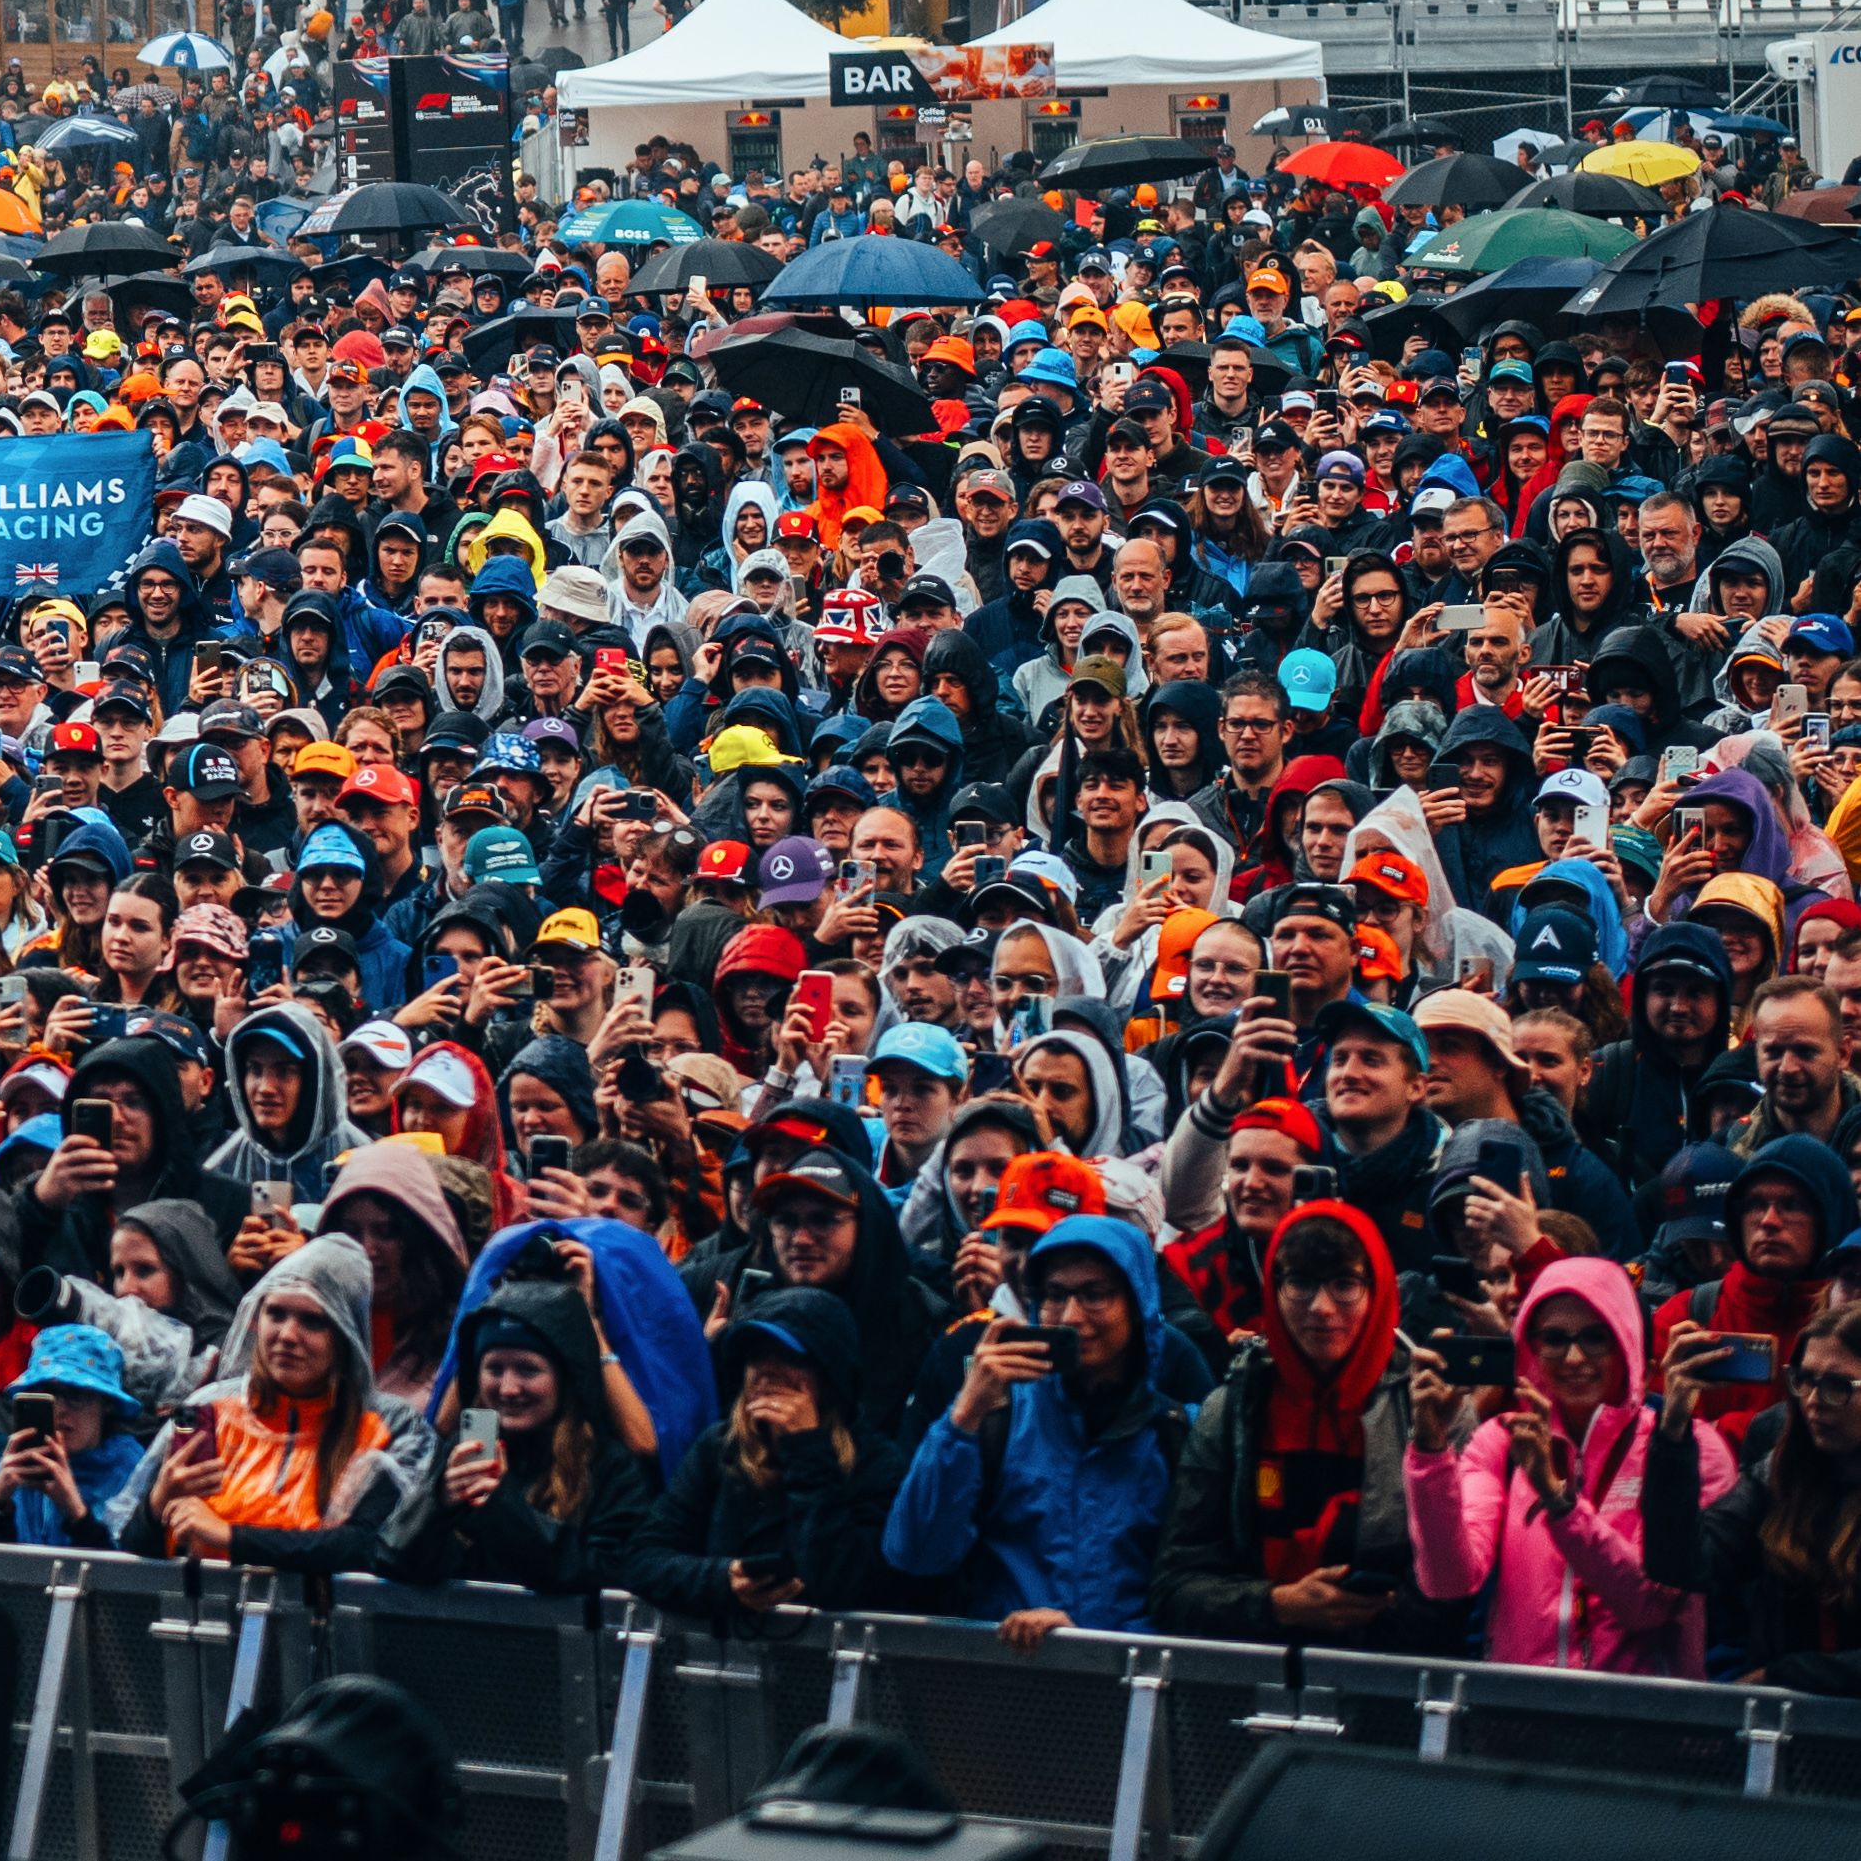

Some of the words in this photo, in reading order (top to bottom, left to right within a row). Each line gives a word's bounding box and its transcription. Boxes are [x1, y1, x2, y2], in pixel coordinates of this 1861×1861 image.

[843, 65, 914, 95] BAR
[918, 107, 945, 116] Coffee
[918, 115, 947, 124] Corner
[614, 229, 651, 240] BOSS
